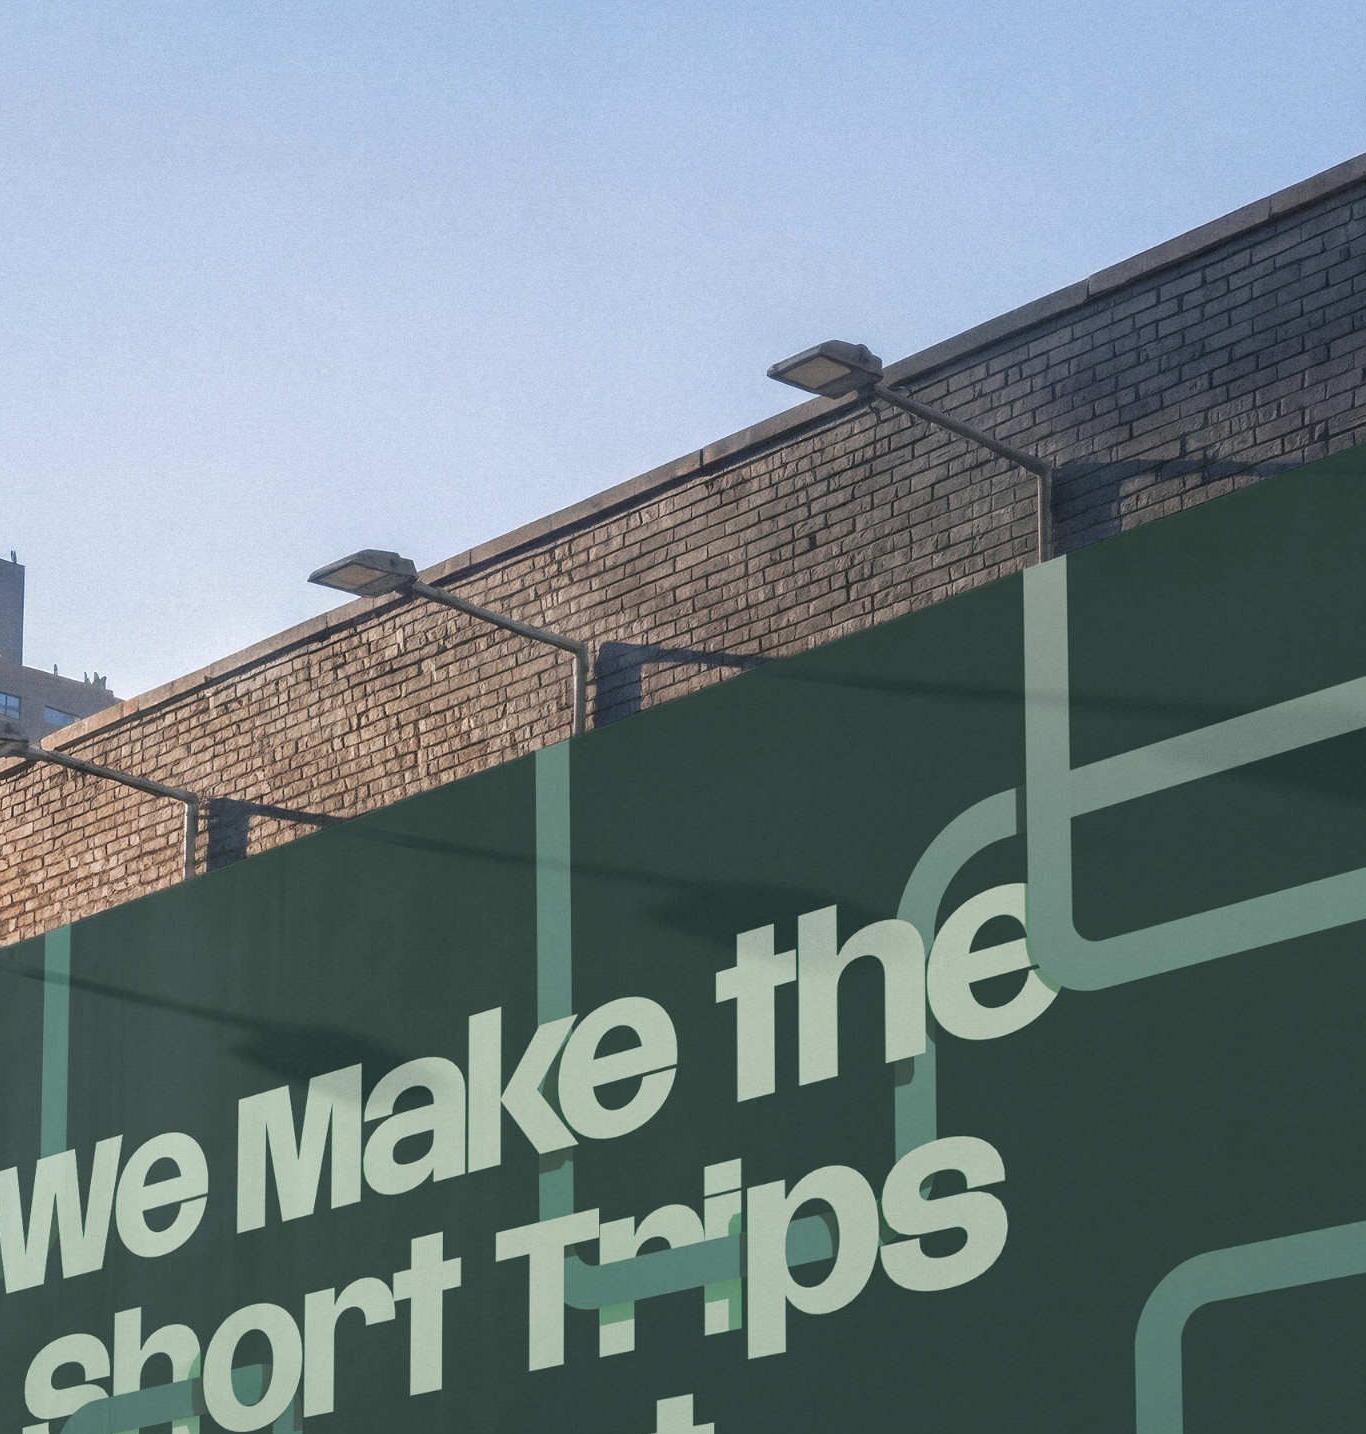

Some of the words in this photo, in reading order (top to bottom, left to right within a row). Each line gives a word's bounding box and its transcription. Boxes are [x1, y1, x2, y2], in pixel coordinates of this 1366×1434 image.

[236, 996, 678, 1234] Make
[715, 882, 1063, 1103] the
[495, 1135, 1009, 1372] Trips
